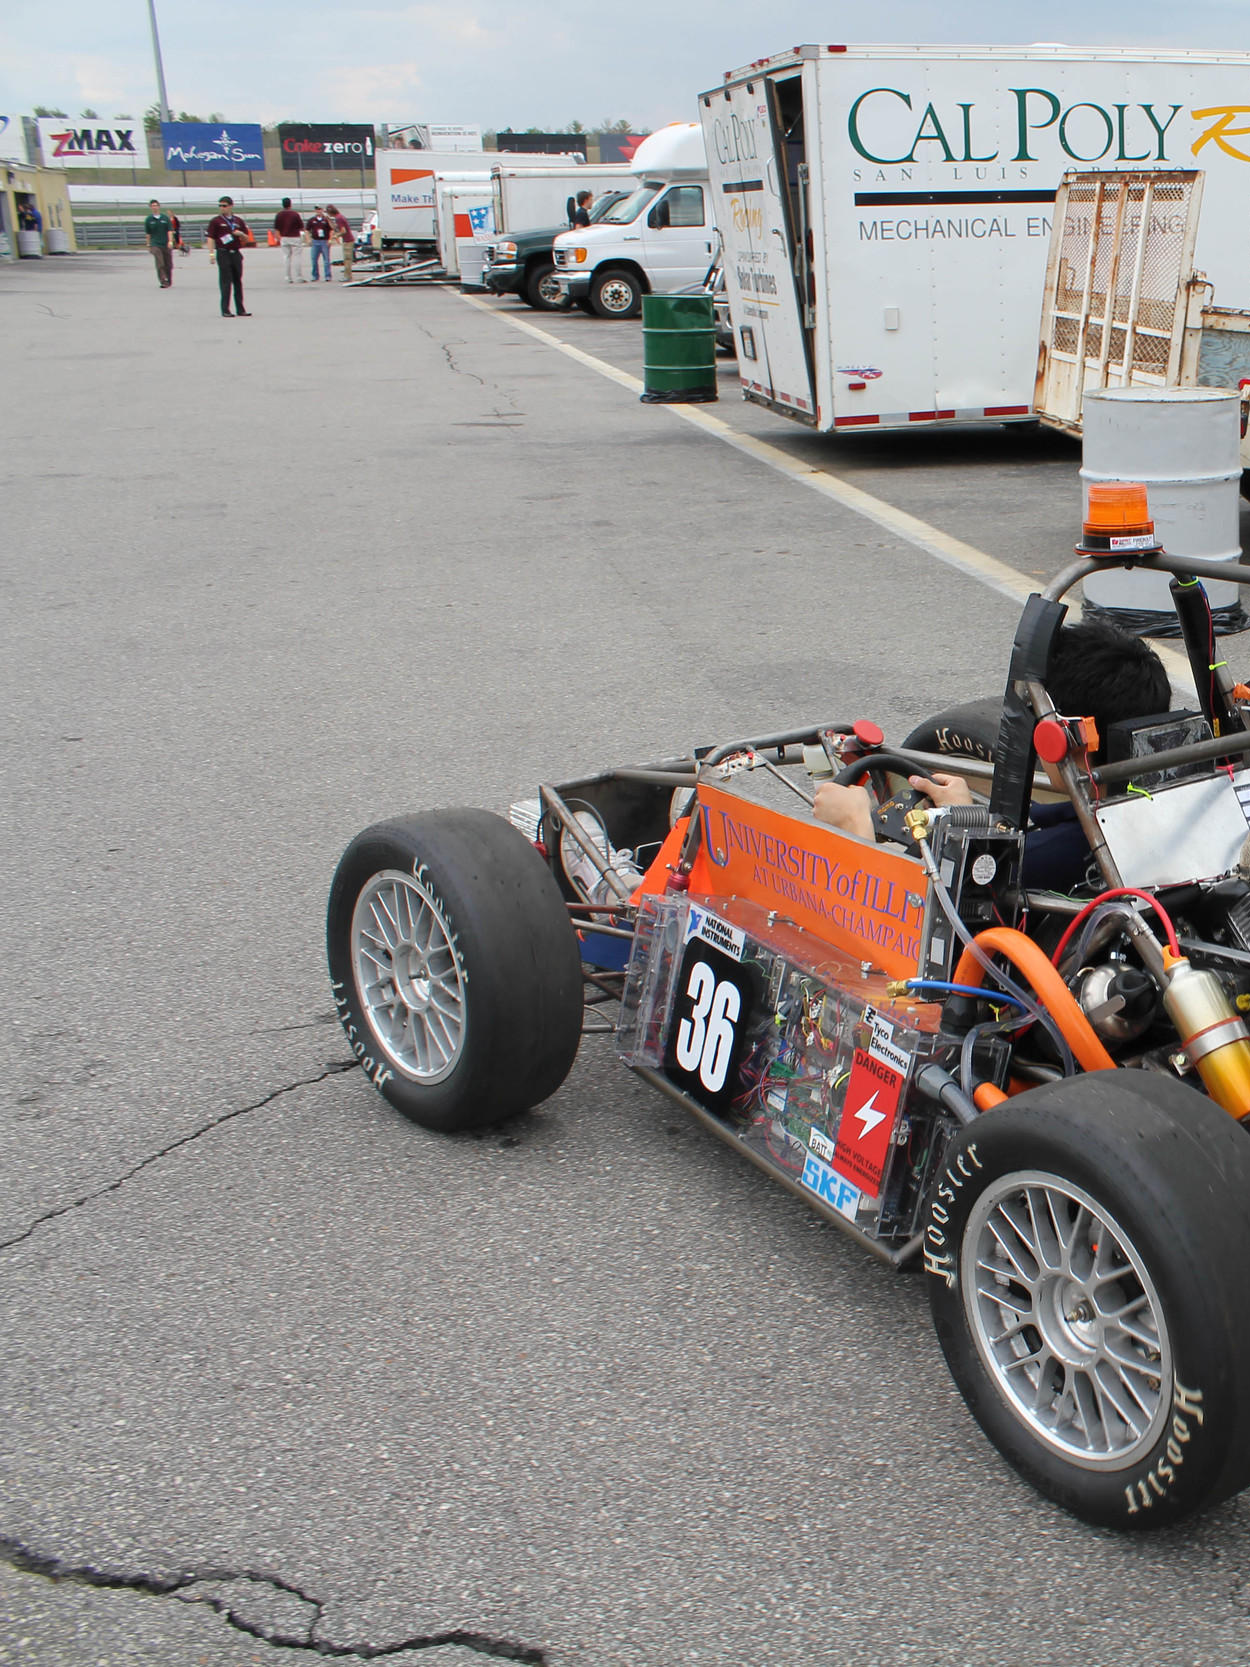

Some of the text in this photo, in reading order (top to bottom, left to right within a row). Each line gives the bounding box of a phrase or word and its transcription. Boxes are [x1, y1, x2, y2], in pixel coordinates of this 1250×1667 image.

[847, 88, 1000, 164] CAL
[1008, 88, 1184, 162] POLY
[230, 148, 262, 163] Sun
[323, 141, 363, 154] zero
[853, 167, 1029, 182] SAN LUIS
[391, 193, 435, 204] Make Th
[858, 217, 1016, 241] MECHANICAL
[935, 727, 992, 763] Hoosi
[700, 803, 841, 892] UNIVERSITY
[836, 869, 863, 902] of
[753, 864, 769, 888] AT
[701, 925, 740, 956] INSTRUMENTS
[705, 915, 733, 939] NATIONAL
[676, 961, 741, 1093] 36
[873, 1022, 889, 1040] Tyco
[871, 1036, 908, 1069] Electronics
[855, 1052, 897, 1088] DANGER
[853, 1151, 881, 1177] VOLTAGE
[802, 1158, 858, 1210] SKF
[923, 1143, 984, 1290] Hoosier
[1124, 1366, 1204, 1514] Hoosier
